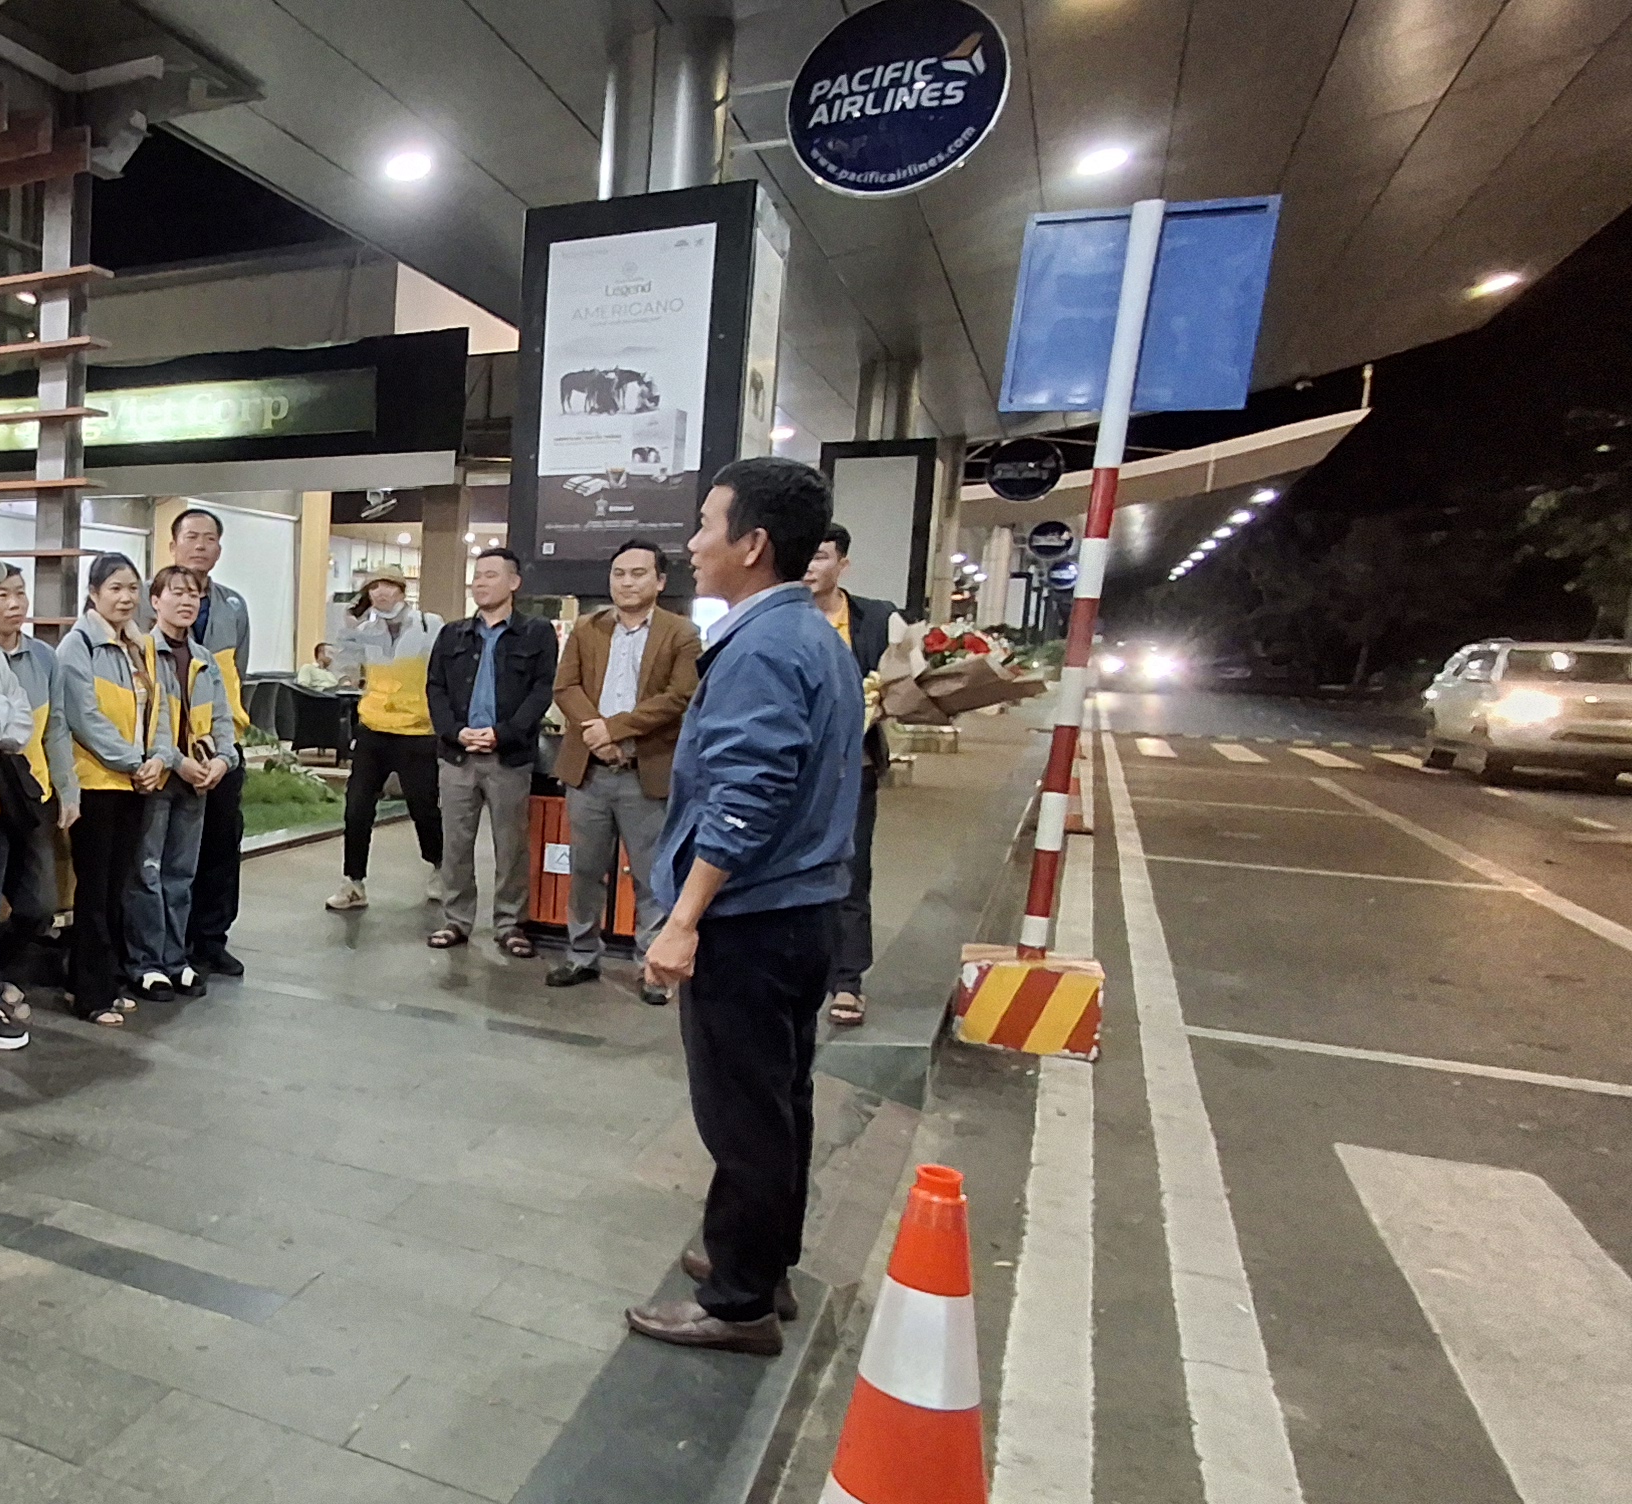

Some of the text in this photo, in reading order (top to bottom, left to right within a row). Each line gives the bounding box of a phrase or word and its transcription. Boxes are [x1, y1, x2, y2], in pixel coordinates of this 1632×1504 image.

[809, 57, 938, 105] PACIFIC
[807, 80, 968, 129] AIRLINES
[810, 126, 976, 184] www.pacificairlines.com
[571, 297, 684, 320] AMERICANO
[604, 280, 652, 297] Legend
[185, 392, 289, 430] Corp
